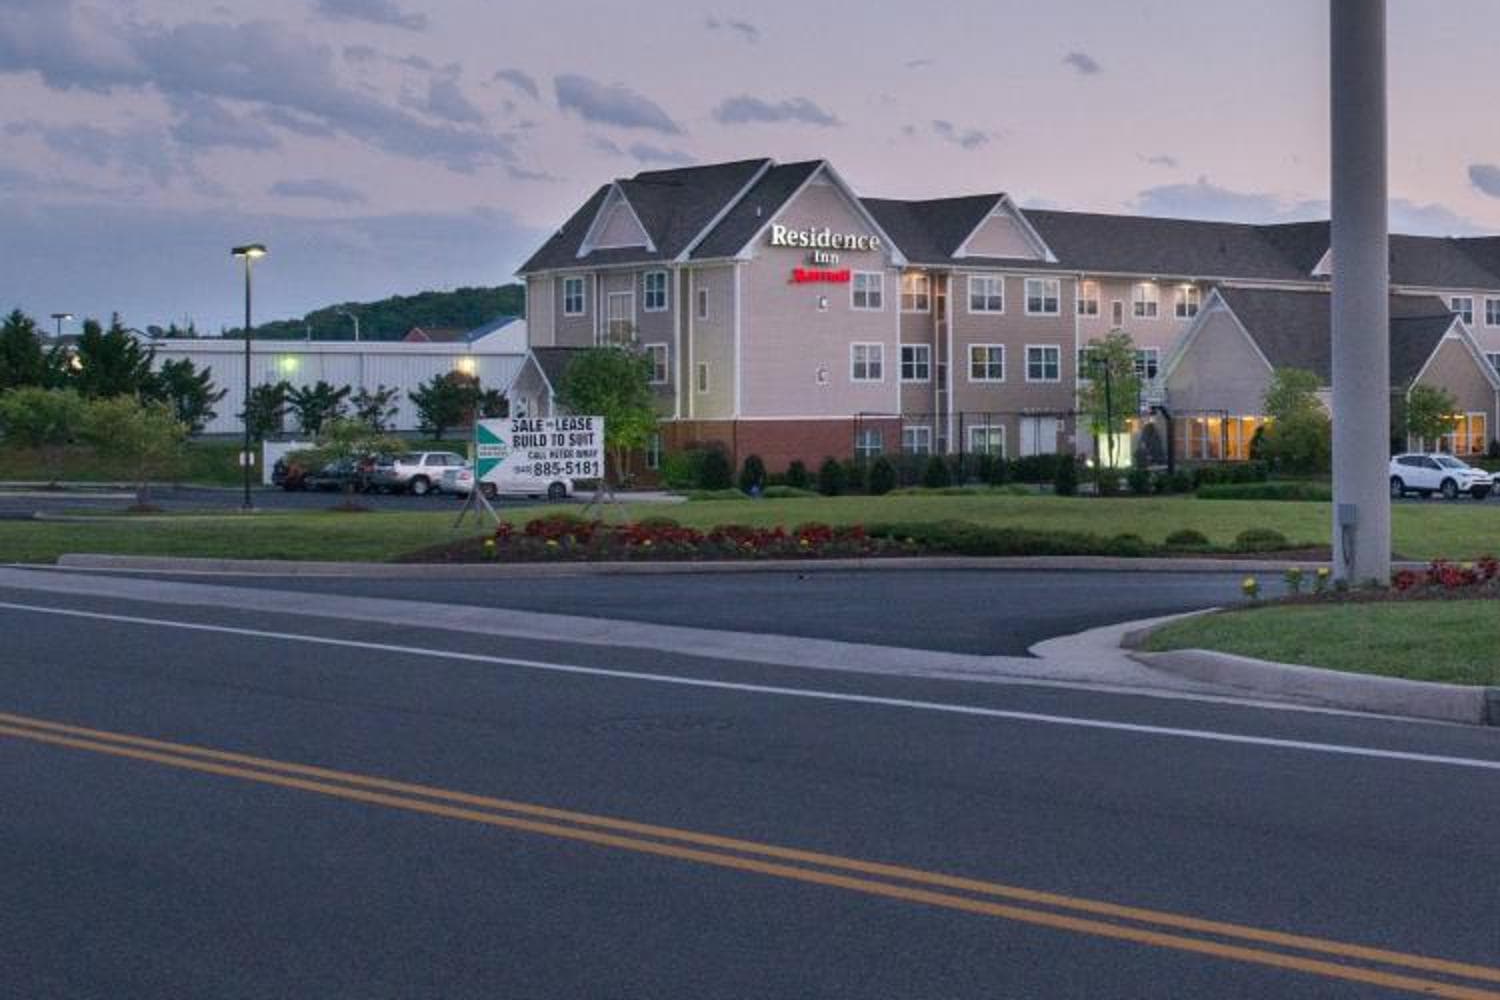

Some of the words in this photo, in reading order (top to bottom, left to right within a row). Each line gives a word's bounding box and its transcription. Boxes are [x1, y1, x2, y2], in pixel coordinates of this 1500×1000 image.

[771, 223, 881, 251] Residence
[814, 250, 840, 264] Inn
[512, 419, 544, 433] SALE
[555, 417, 593, 431] LEASE
[513, 433, 547, 448] BUILD
[551, 433, 565, 447] TO
[533, 460, 600, 477] 885-5181
